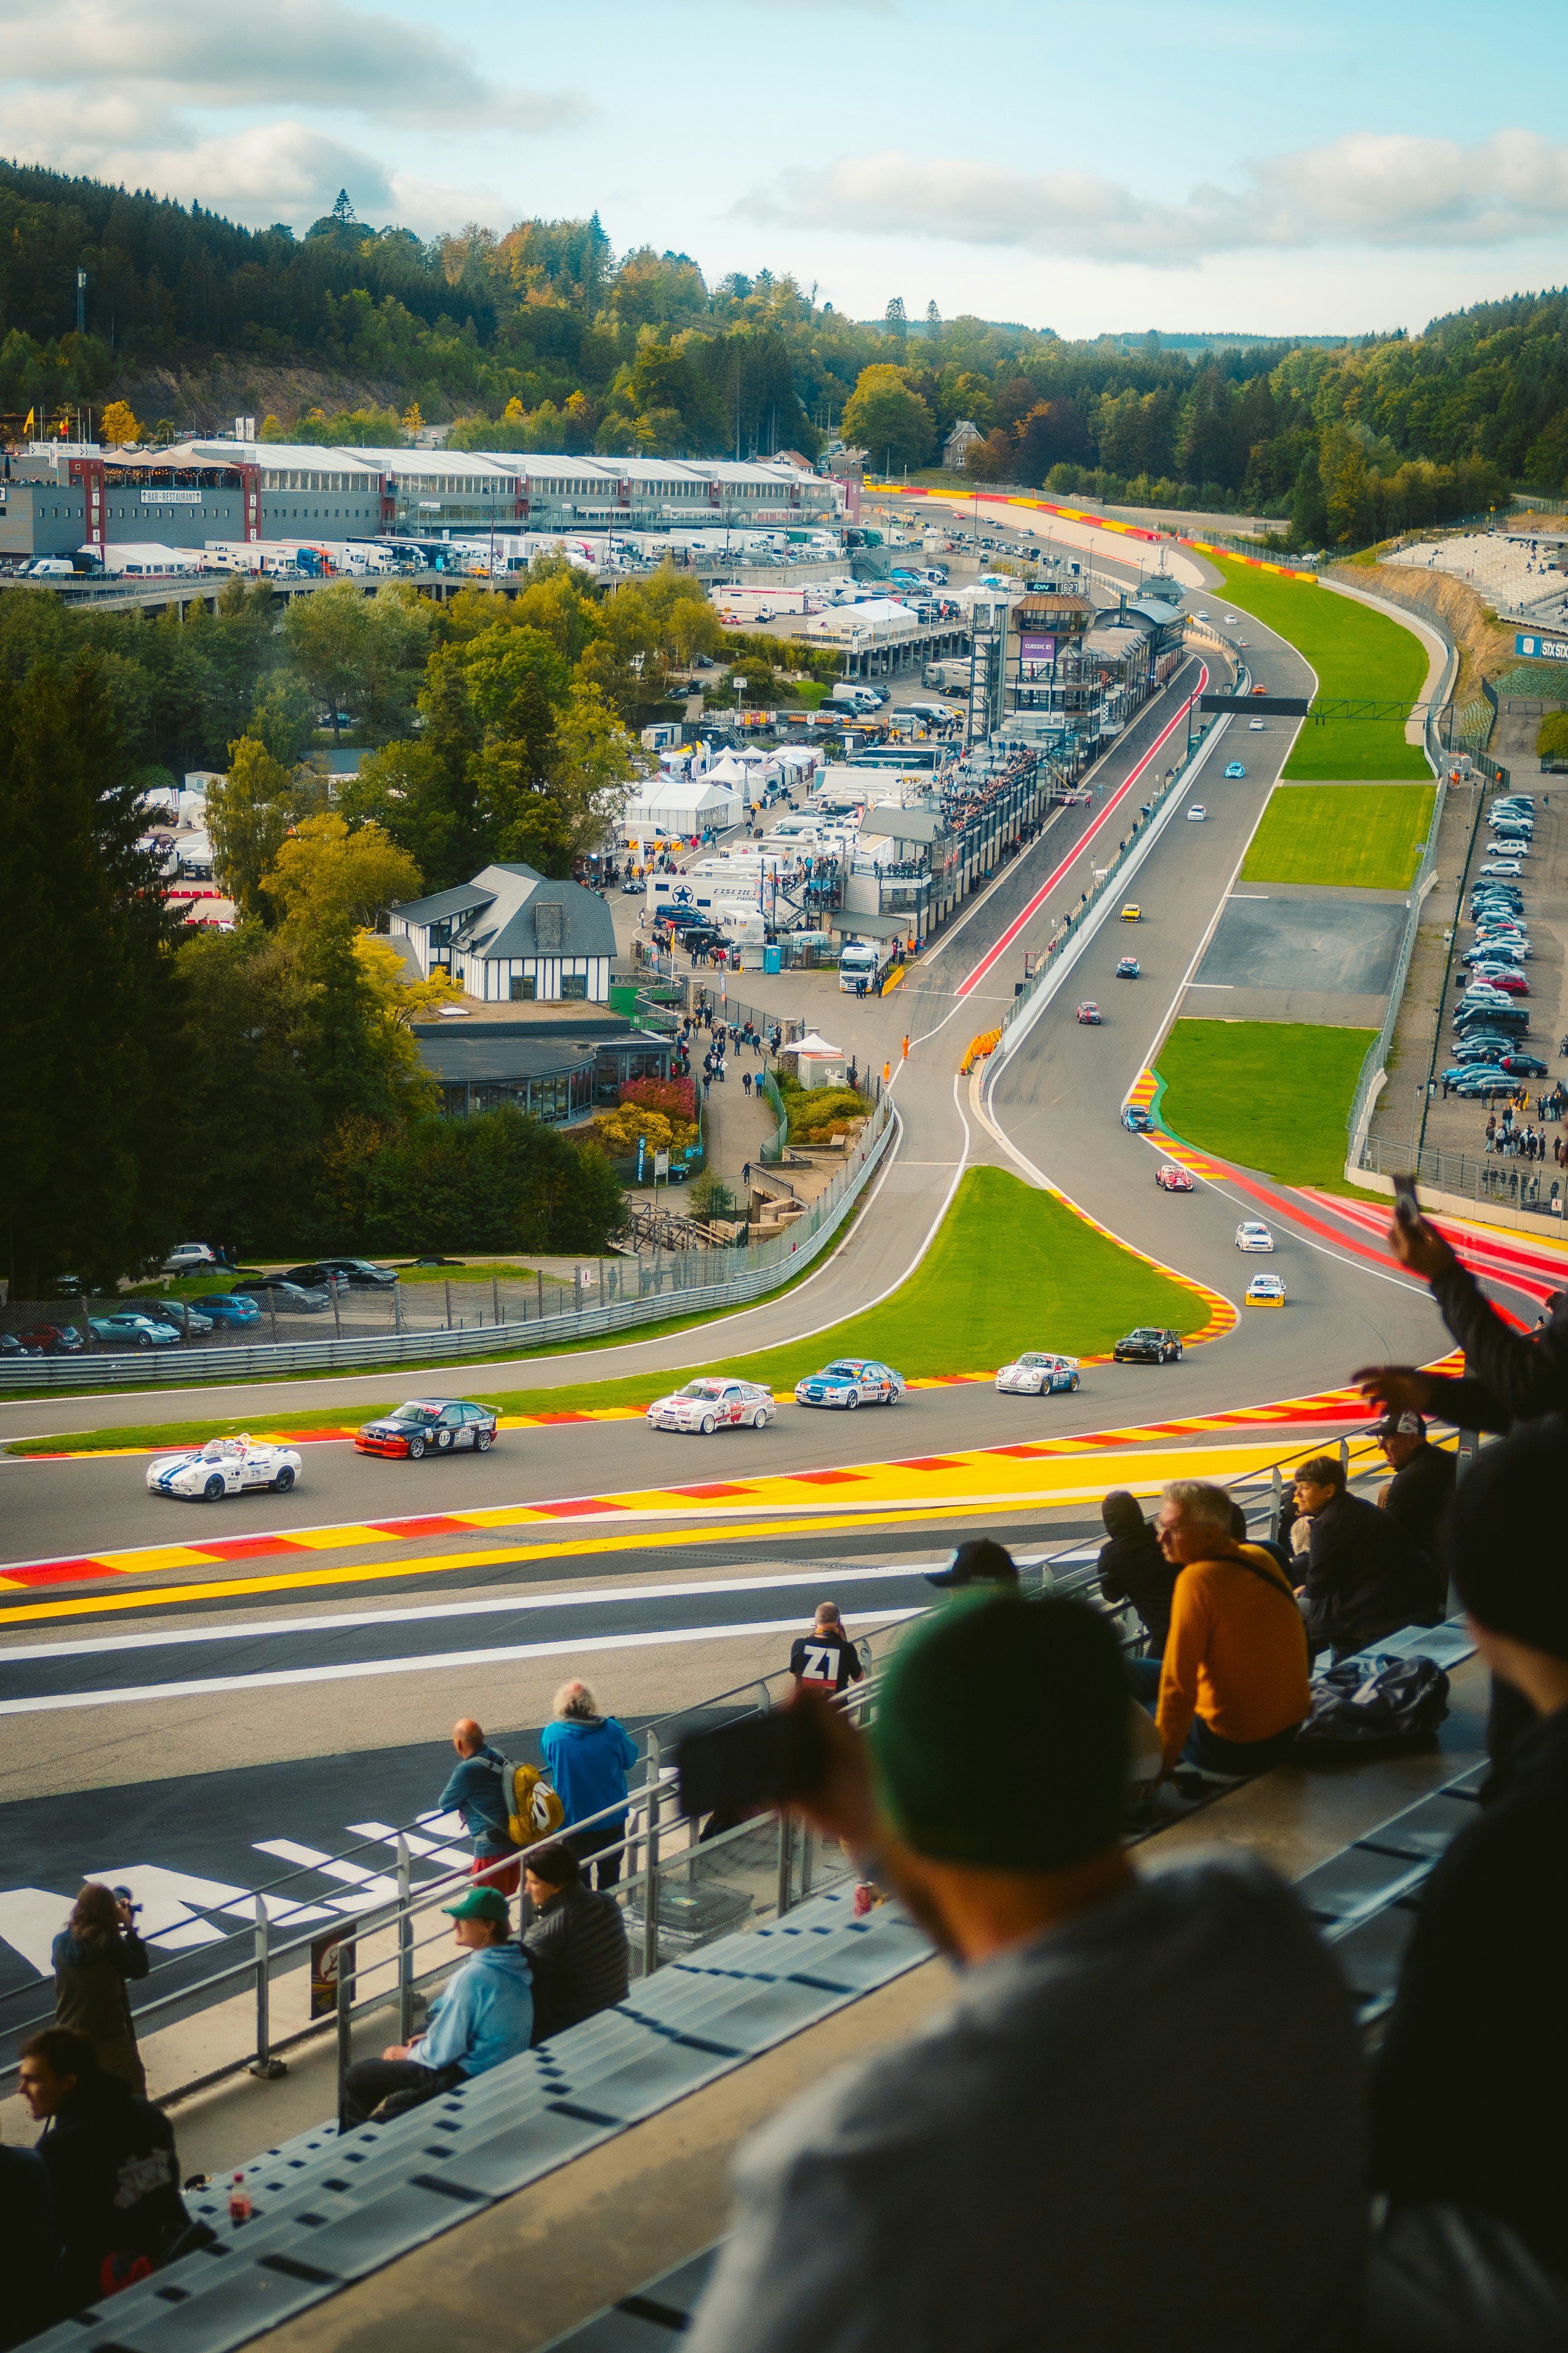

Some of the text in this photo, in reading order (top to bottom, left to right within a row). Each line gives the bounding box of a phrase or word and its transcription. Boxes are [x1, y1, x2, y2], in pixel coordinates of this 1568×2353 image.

[251, 496, 255, 505] 2
[251, 530, 255, 539] 2
[720, 1409, 725, 1418] 7
